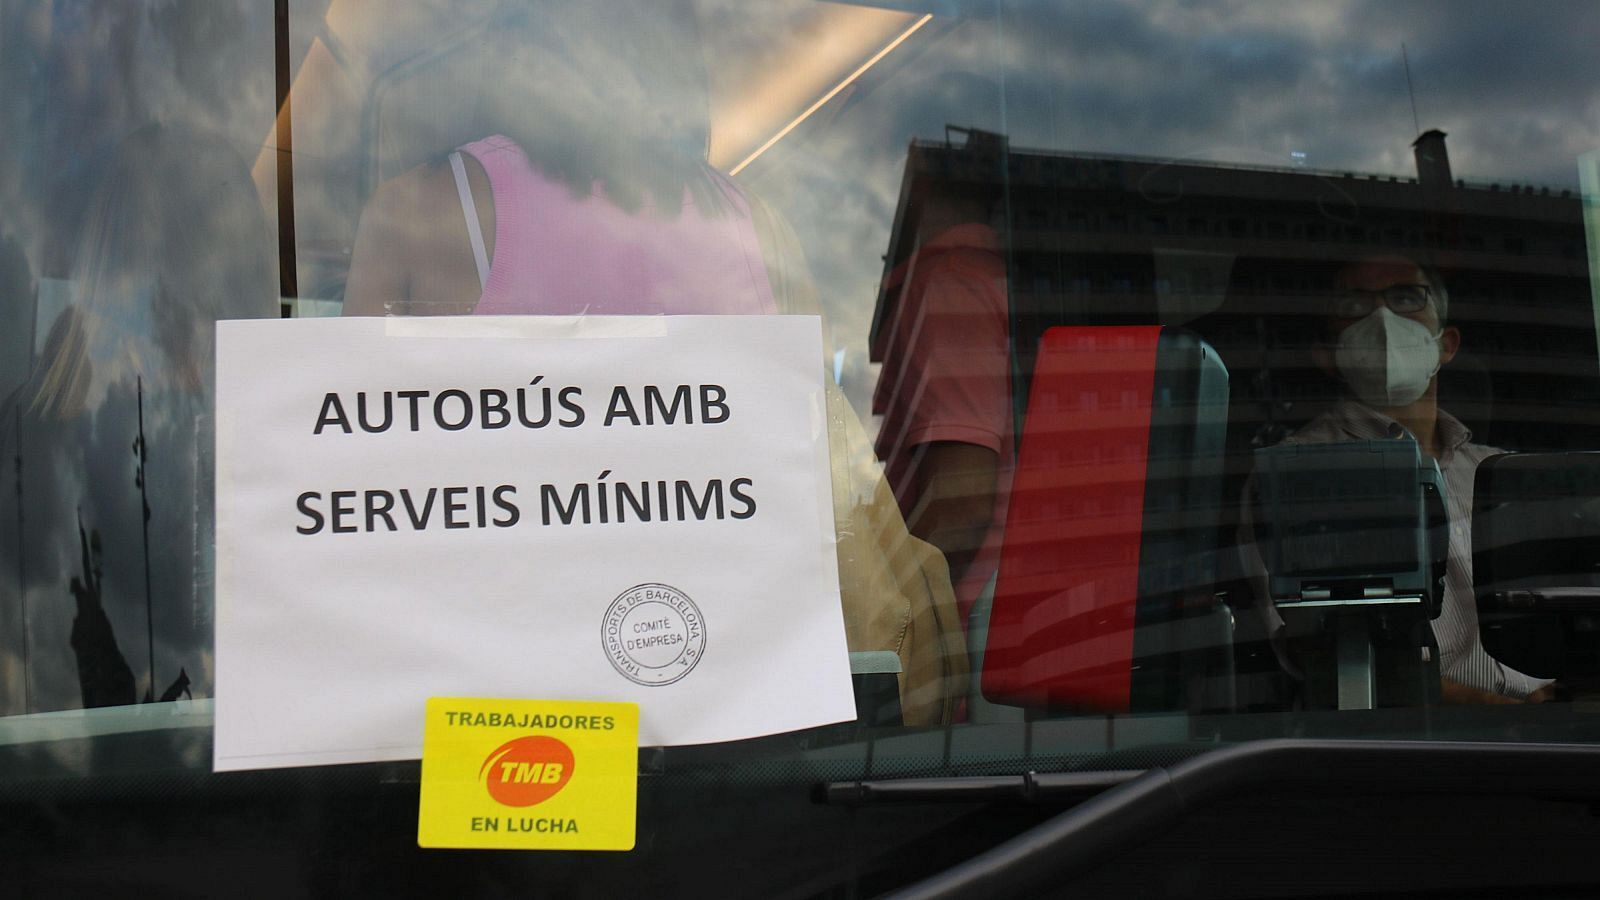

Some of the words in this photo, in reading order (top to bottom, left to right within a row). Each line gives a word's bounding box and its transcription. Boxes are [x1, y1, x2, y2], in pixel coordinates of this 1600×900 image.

[313, 376, 585, 434] AUTOBÚS
[603, 385, 731, 426] AMB
[296, 484, 520, 535] SERVEIS
[540, 470, 757, 526] MÍNIMS
[608, 604, 640, 676] TRANSPORTS
[626, 592, 643, 606] DE
[446, 711, 615, 730] TRABAJADORES
[500, 762, 563, 784] TMB
[471, 817, 498, 832] EN
[507, 818, 578, 833] LUCHA
